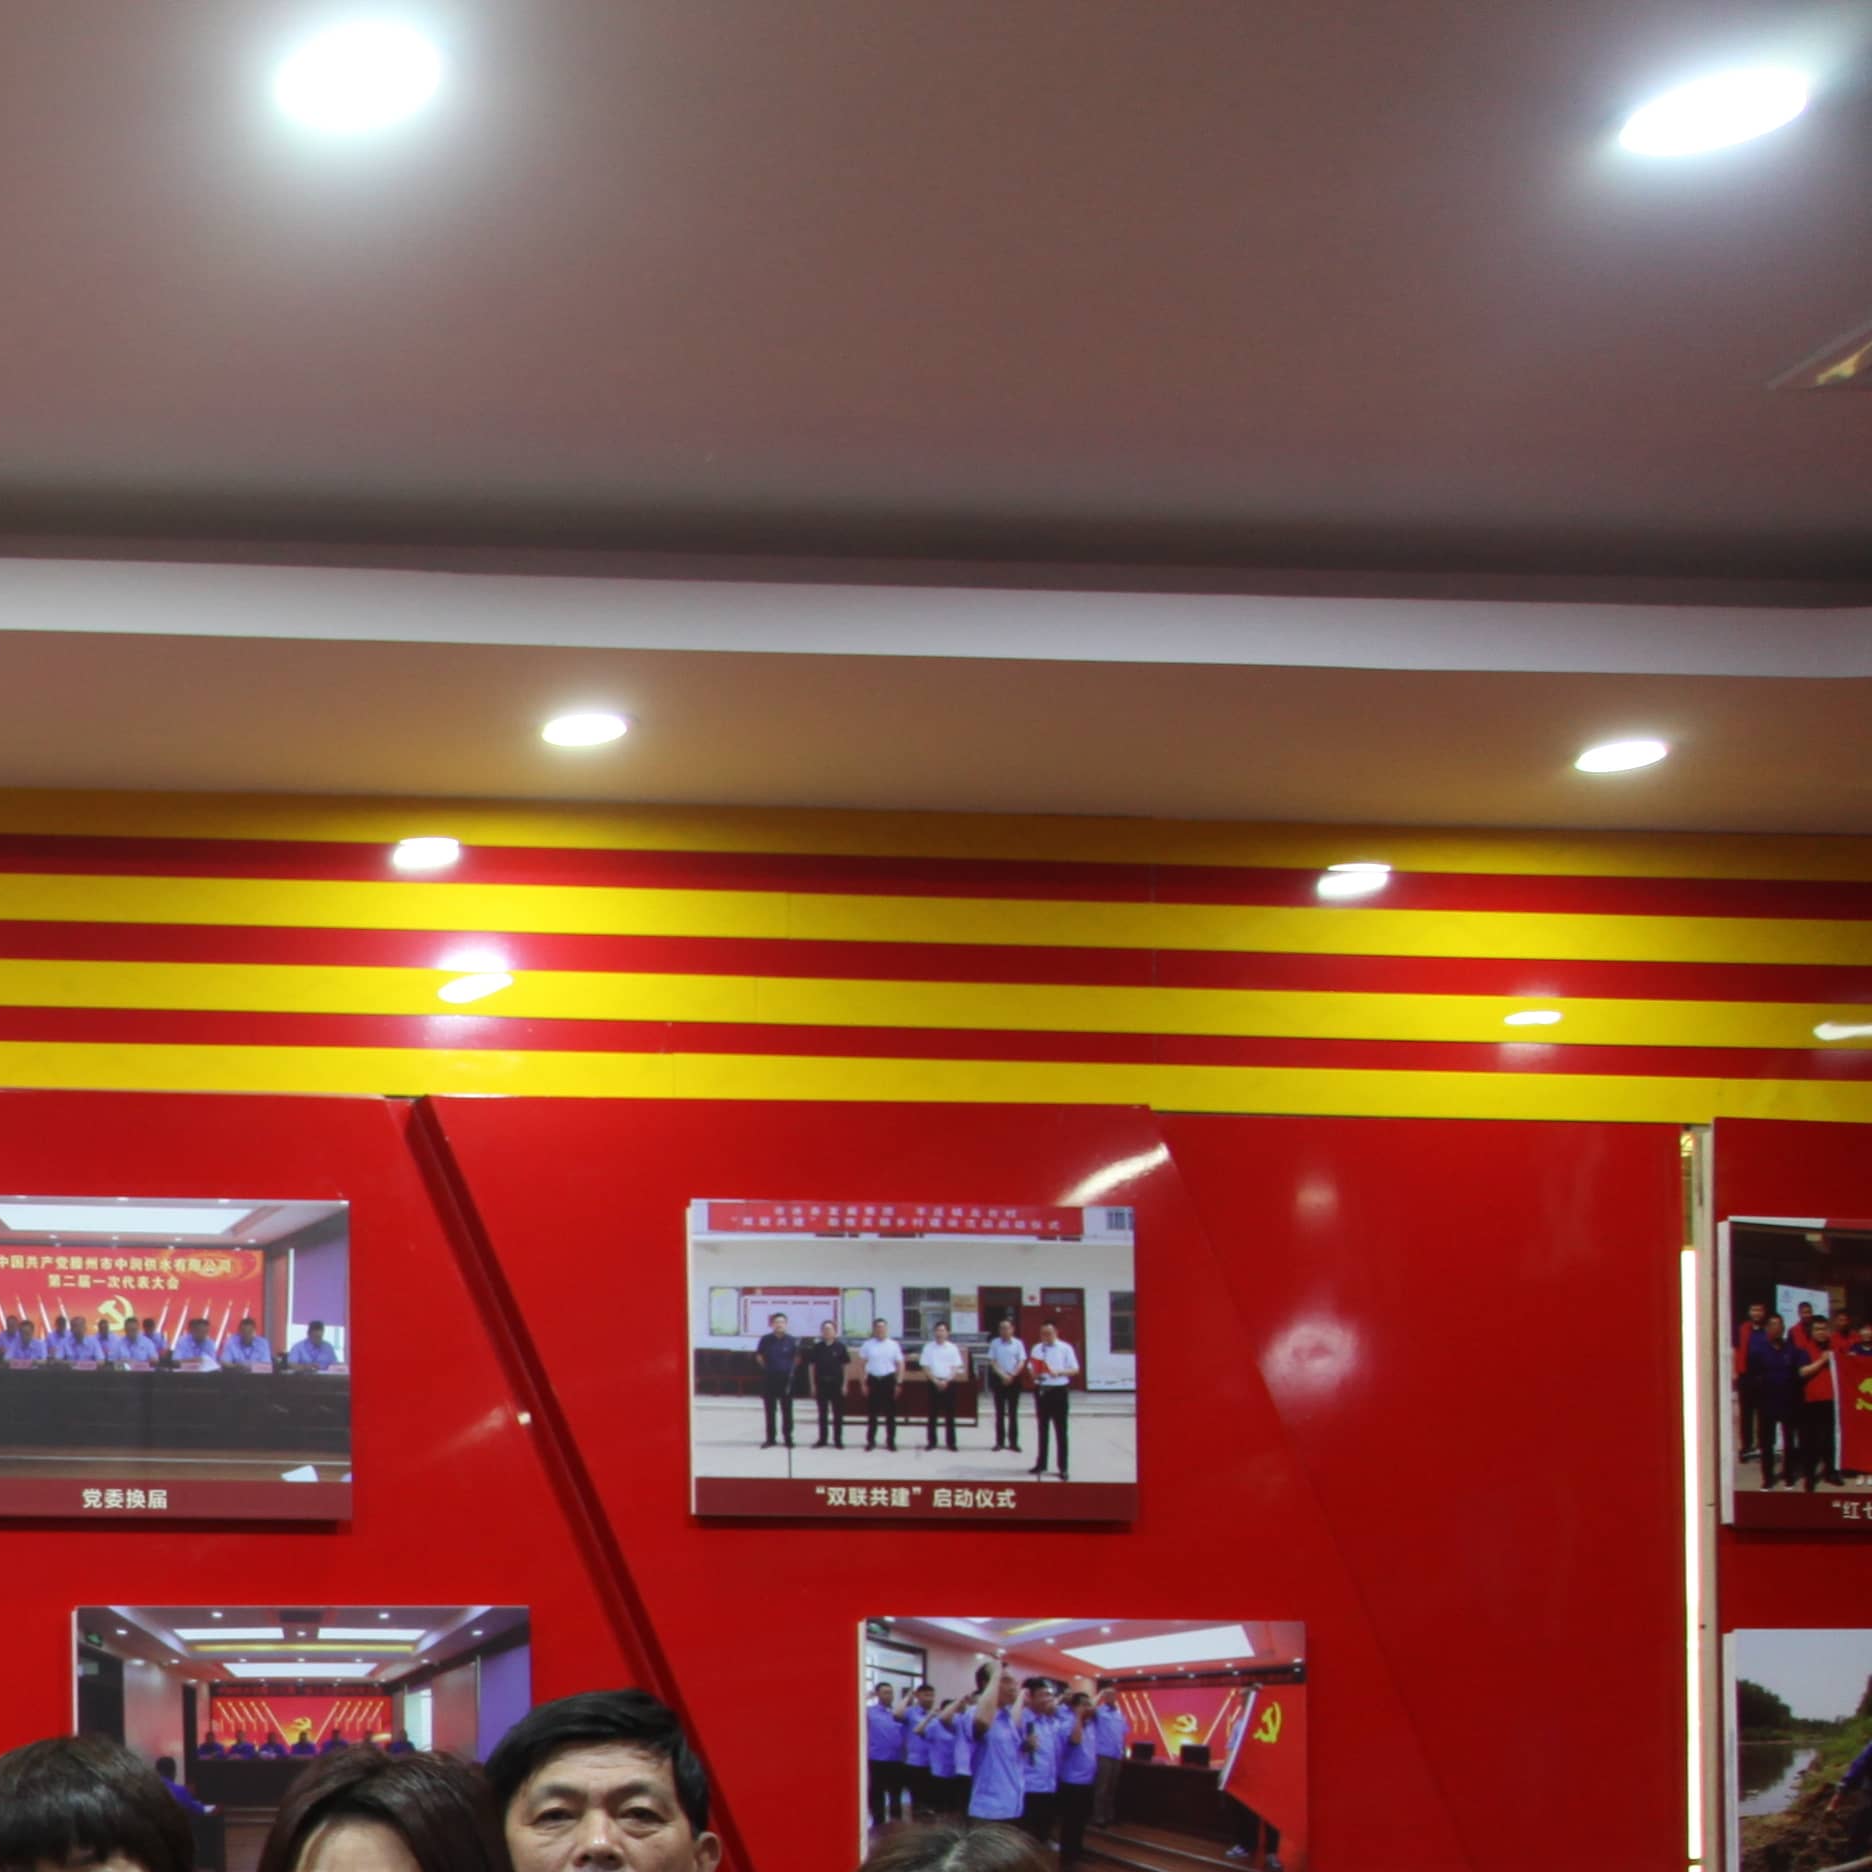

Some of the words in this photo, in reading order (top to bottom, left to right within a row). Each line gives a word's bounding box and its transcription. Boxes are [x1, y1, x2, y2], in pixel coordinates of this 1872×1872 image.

[48, 1274, 180, 1291] 第二届一次代表大会
[82, 1488, 168, 1510] 党委换届
[814, 1486, 1017, 1510] “双联共建”启动仪式
